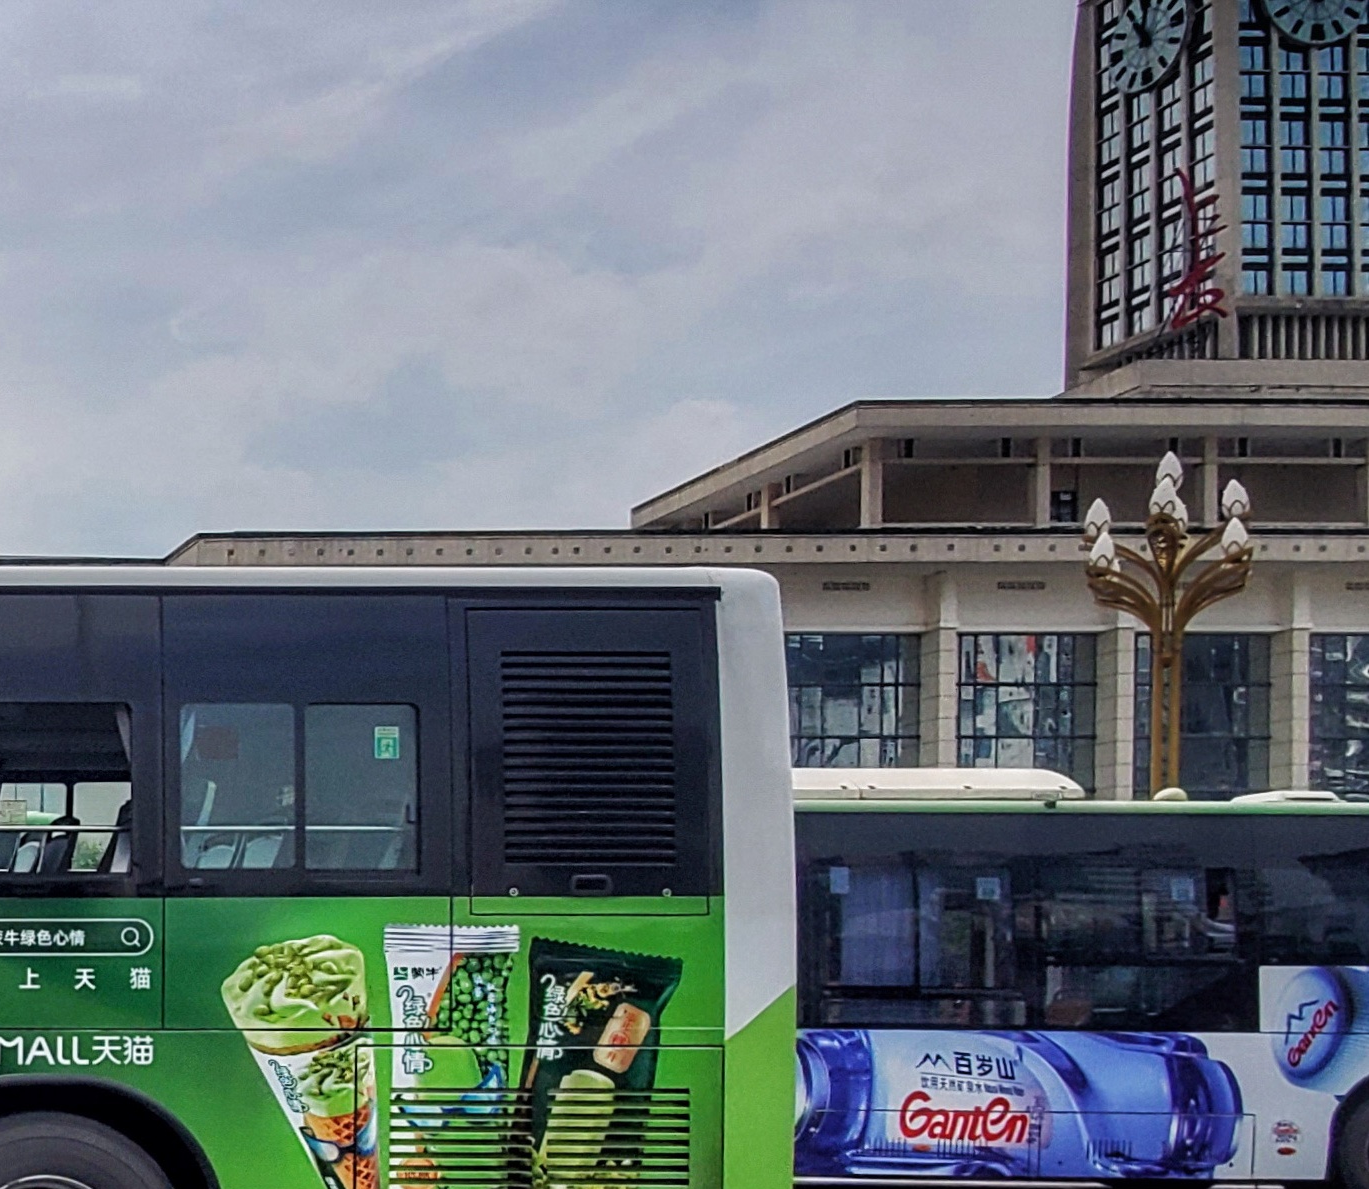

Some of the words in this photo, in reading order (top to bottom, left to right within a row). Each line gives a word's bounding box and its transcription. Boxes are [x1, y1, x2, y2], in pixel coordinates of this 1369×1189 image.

[953, 1051, 1016, 1080] 百岁山
[899, 1090, 1029, 1144] Ganten
